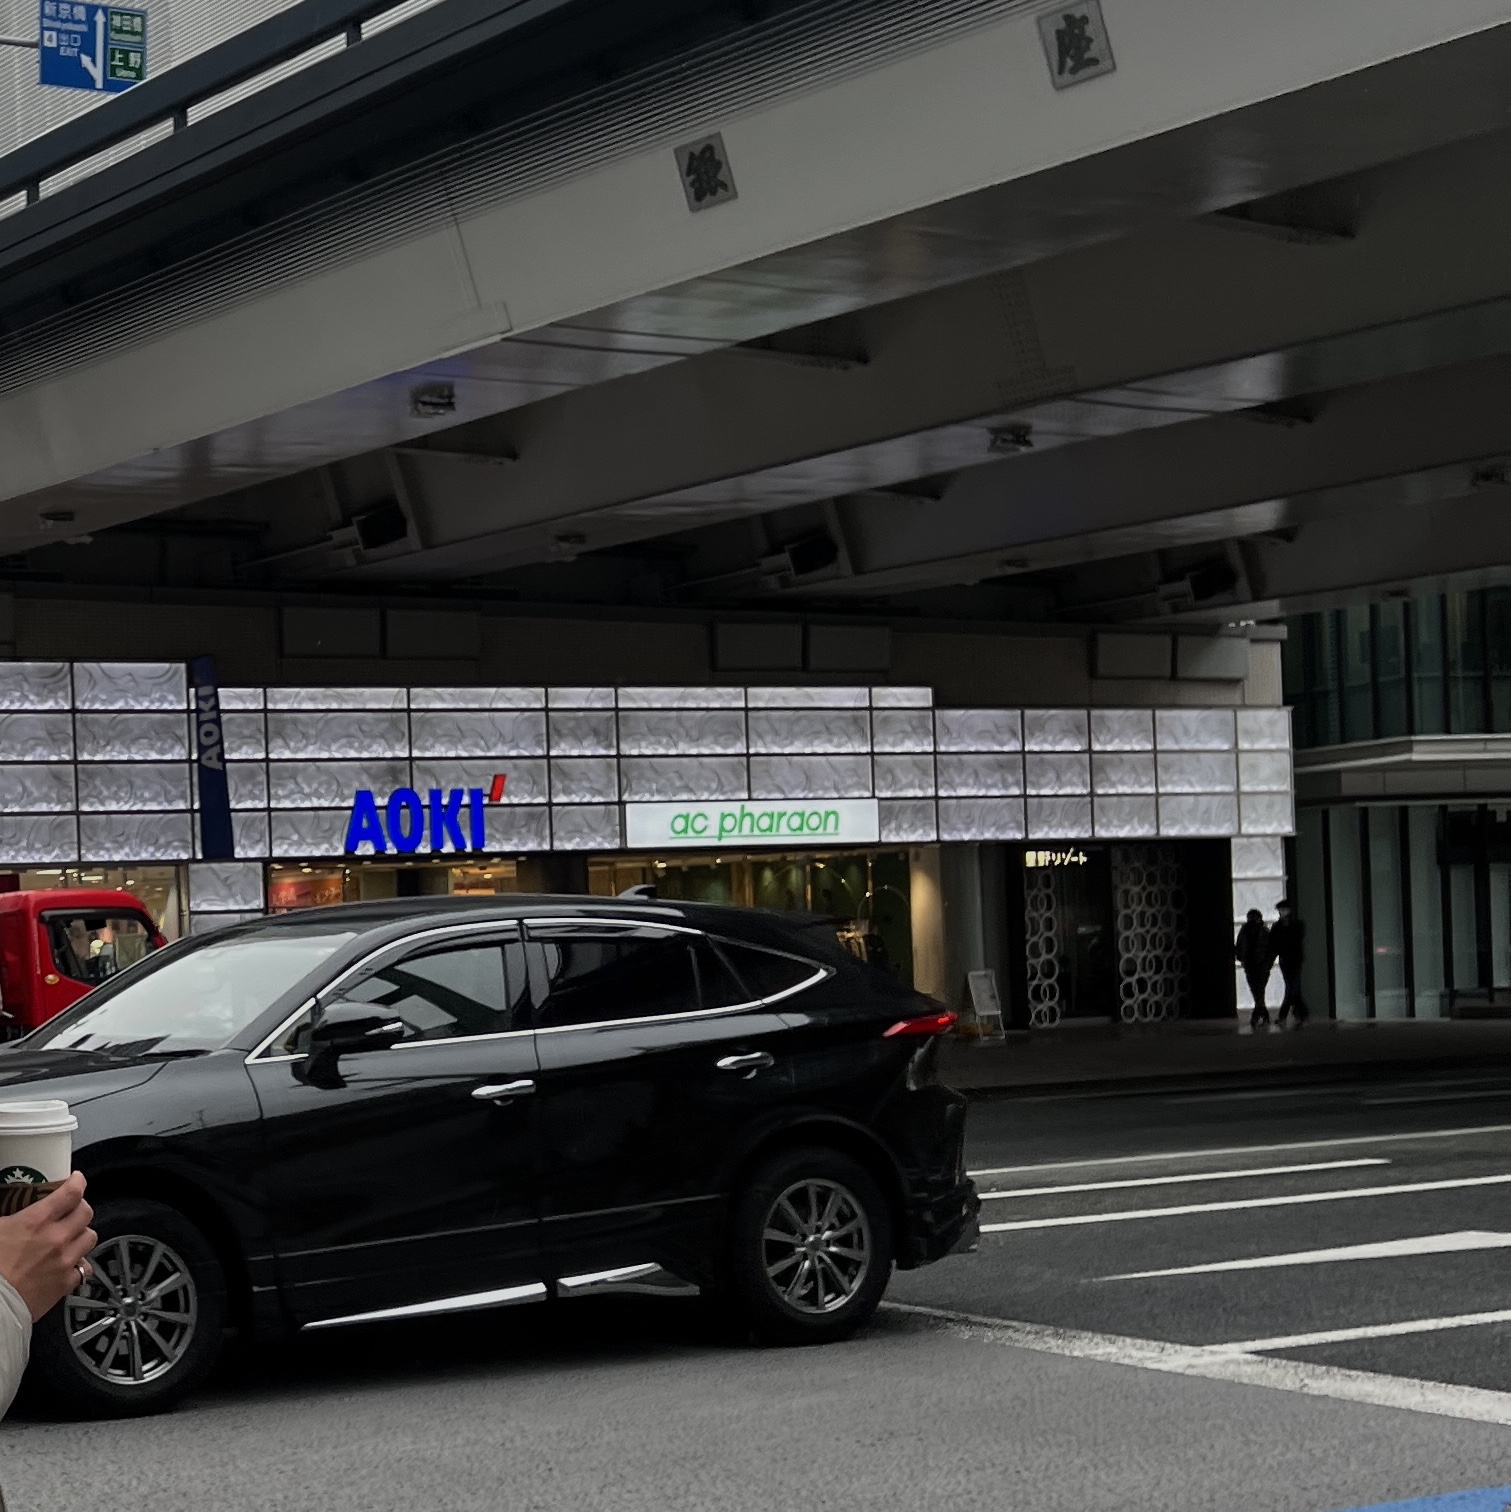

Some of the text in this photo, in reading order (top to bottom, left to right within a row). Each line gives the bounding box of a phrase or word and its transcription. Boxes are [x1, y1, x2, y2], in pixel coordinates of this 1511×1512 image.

[198, 685, 224, 770] AOKI
[344, 788, 485, 853] AOKI
[670, 804, 840, 841] ac pharaon
